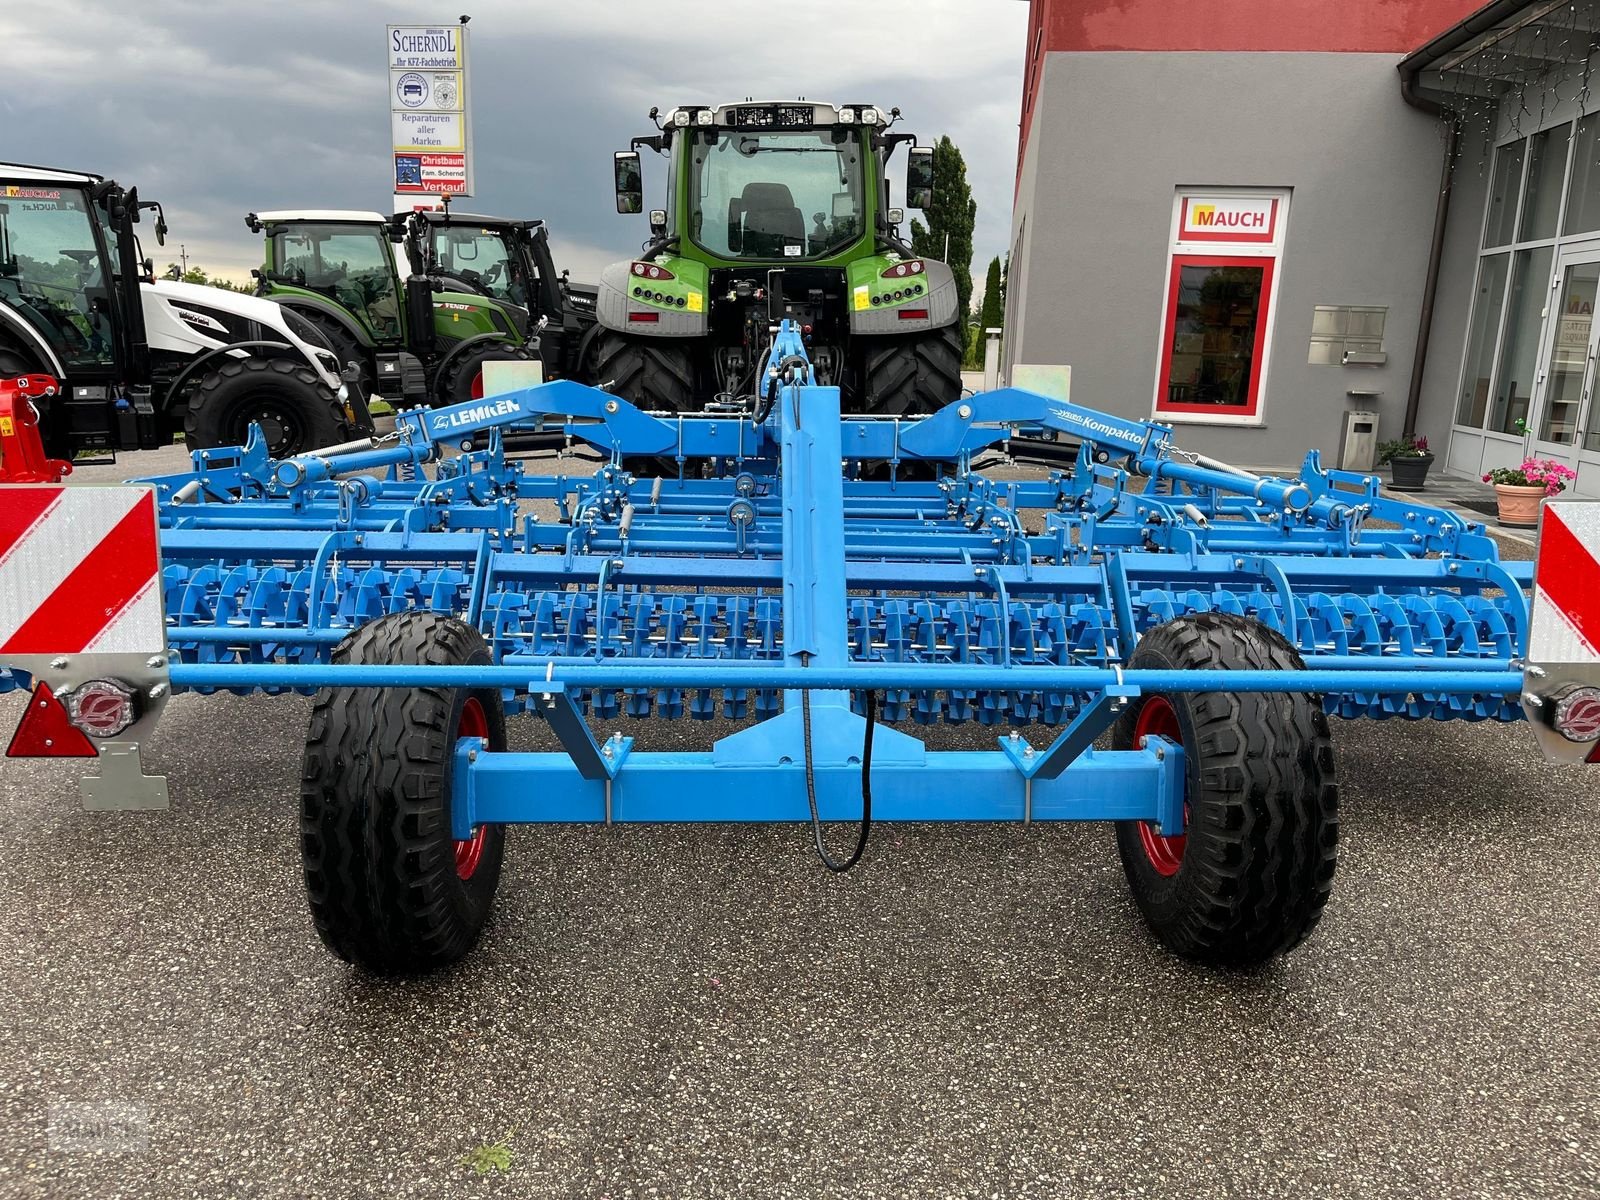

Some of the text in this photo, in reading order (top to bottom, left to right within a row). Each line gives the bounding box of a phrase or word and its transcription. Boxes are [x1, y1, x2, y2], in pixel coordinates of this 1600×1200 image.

[392, 29, 456, 52] SCHERNDL
[407, 57, 457, 67] KFZ-Fachbetrieb
[401, 113, 450, 123] Reparaturen
[416, 125, 436, 134] aller
[411, 136, 442, 145] Marken
[421, 155, 465, 166] Christbaum
[422, 182, 465, 192] Verkauf
[1197, 211, 1265, 227] MAUCH
[445, 302, 470, 311] FENDT
[449, 399, 521, 427] LEMKEN
